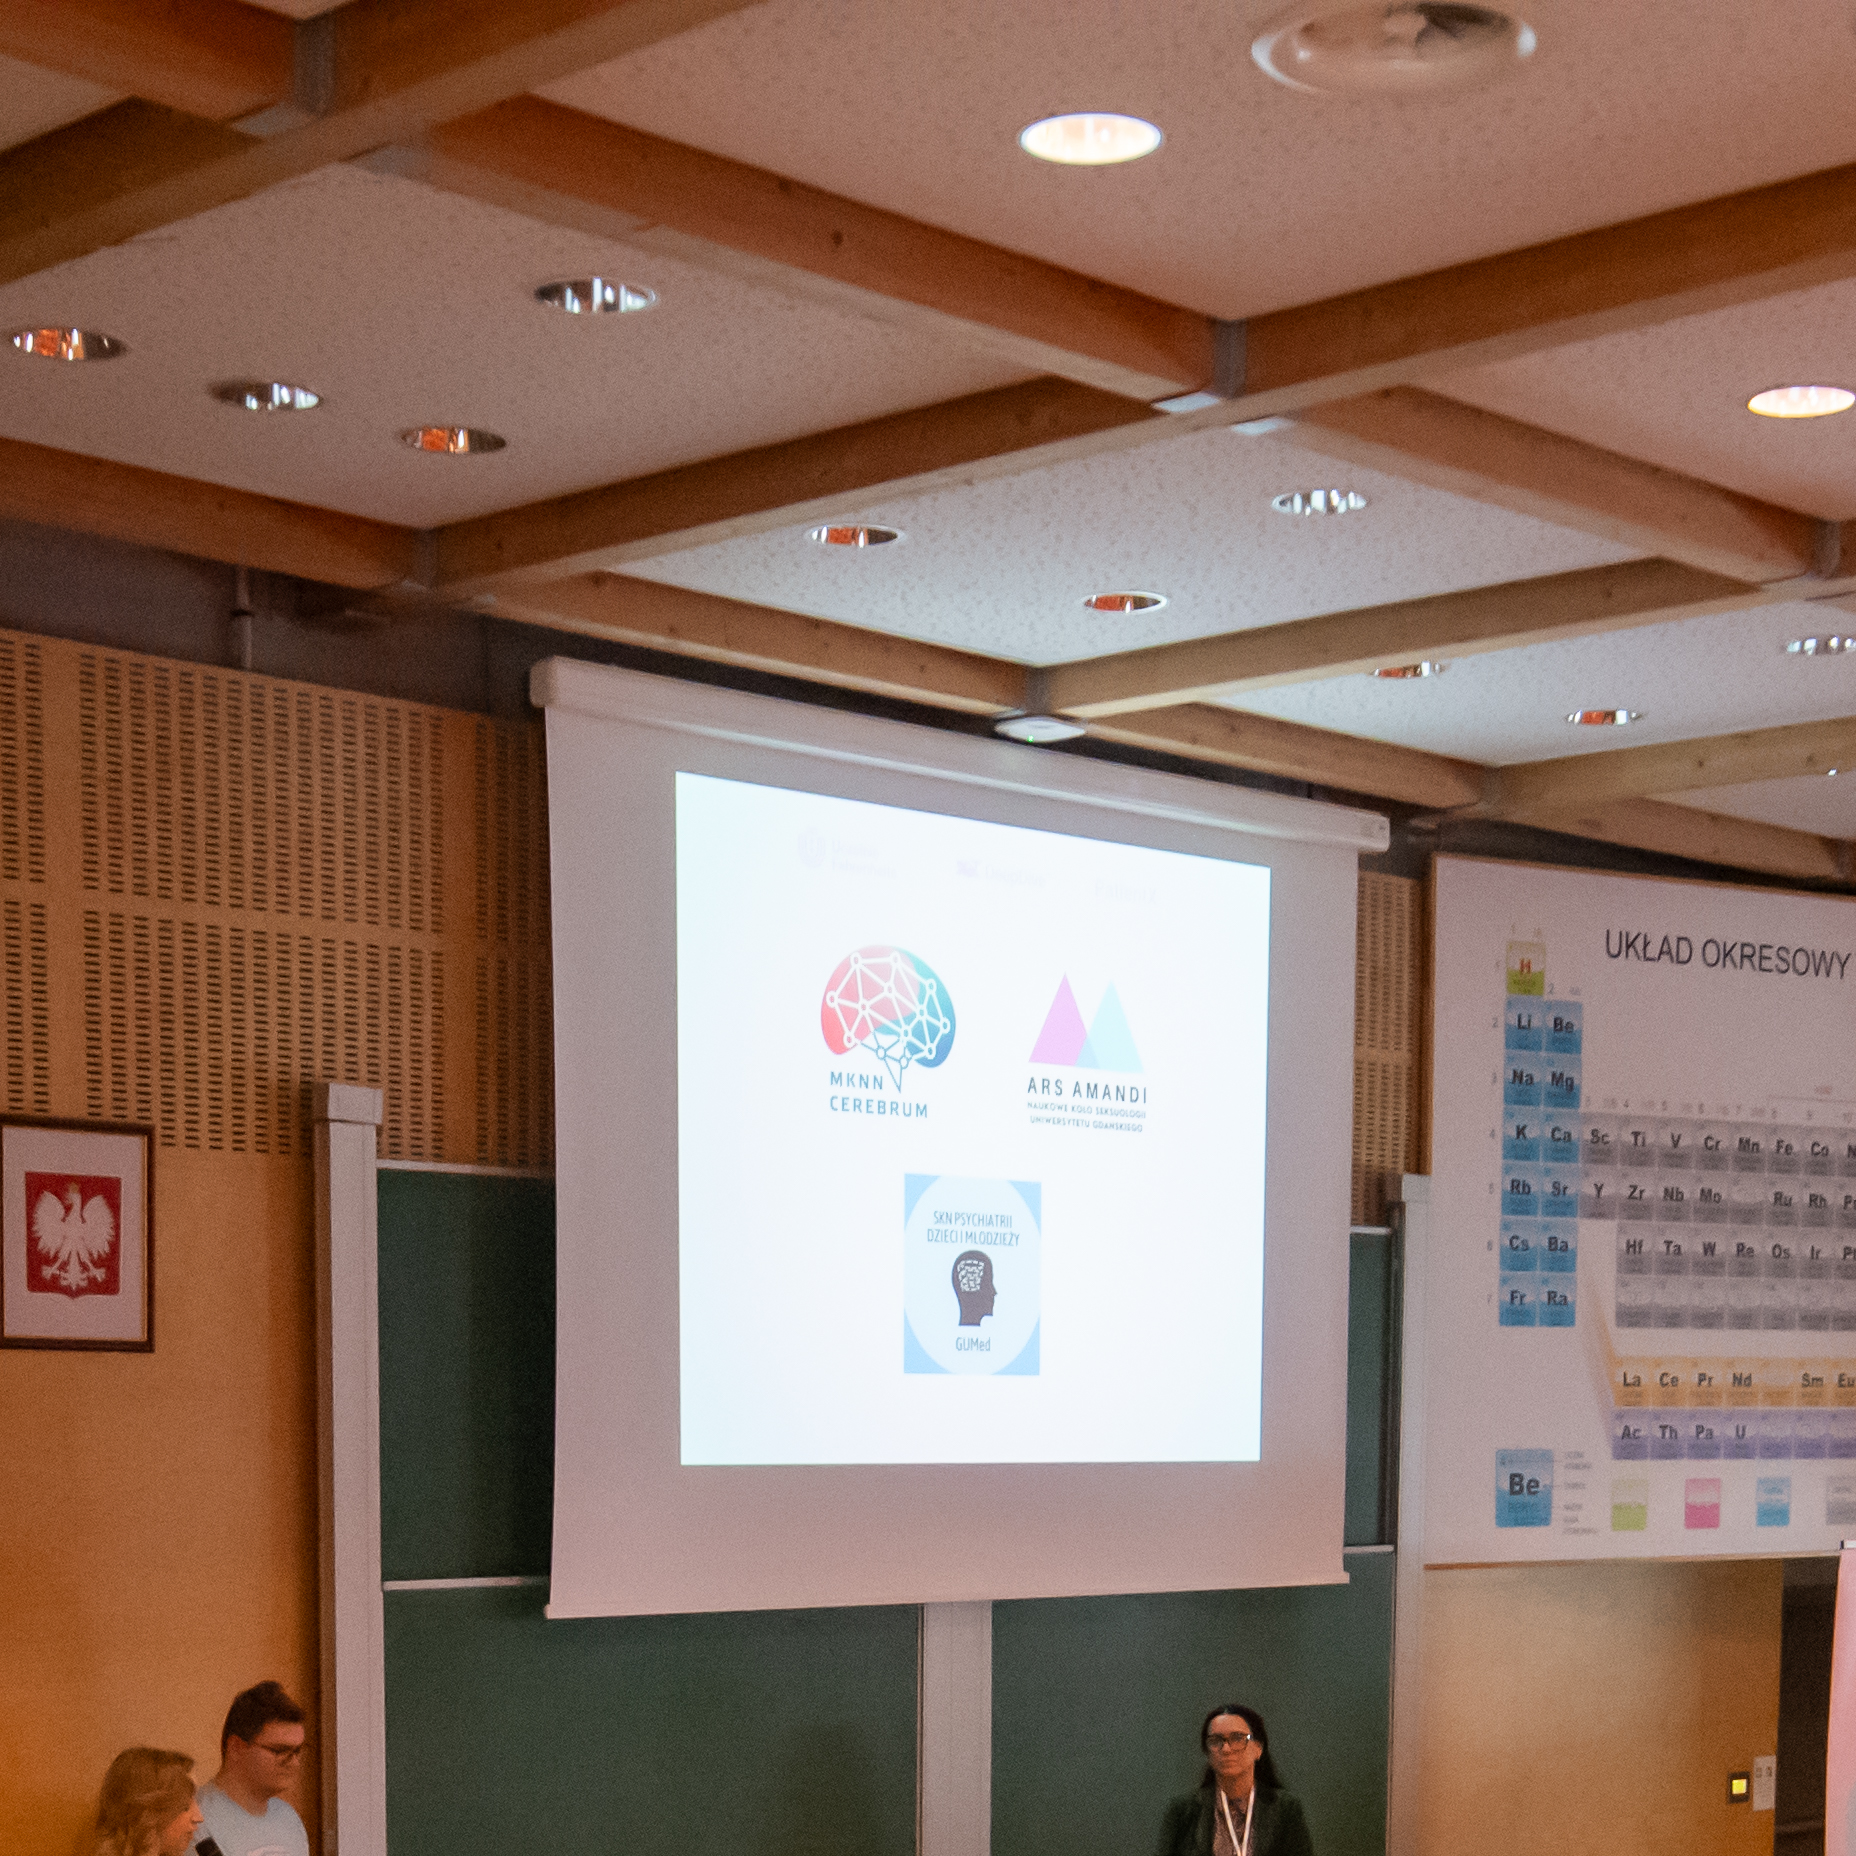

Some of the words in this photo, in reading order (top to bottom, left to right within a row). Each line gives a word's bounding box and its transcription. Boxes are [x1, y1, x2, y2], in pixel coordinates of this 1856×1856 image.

[1604, 929, 1693, 965] UKŁAD
[1701, 938, 1852, 980] OKRESOWY
[1517, 1013, 1532, 1030] Li
[1553, 1016, 1574, 1033] Be
[830, 1070, 883, 1091] MKNN
[1027, 1076, 1063, 1097] ARS
[1072, 1080, 1147, 1105] AMANDI
[1511, 1069, 1534, 1086] Na
[1551, 1071, 1574, 1092] Mg
[829, 1095, 928, 1119] CEREBRUM
[1027, 1101, 1068, 1113] NAUKOWE
[1515, 1125, 1527, 1140] K
[1550, 1127, 1572, 1143] Ca
[1590, 1129, 1610, 1146] Sc
[1631, 1130, 1646, 1147] Ti
[1670, 1133, 1681, 1149] V
[1704, 1135, 1721, 1151] Cr
[1738, 1137, 1760, 1153] Mn
[1776, 1139, 1793, 1156] Fe
[1510, 1179, 1531, 1196] Rb
[1551, 1181, 1568, 1198] Sr
[1594, 1182, 1604, 1199] Y
[1628, 1184, 1646, 1201] Zr
[1663, 1186, 1684, 1203] Nb
[1699, 1187, 1722, 1205] Mo
[1774, 1191, 1793, 1207] Ru
[1809, 1193, 1827, 1209] Rh
[933, 1210, 953, 1225] SKN
[954, 1212, 1013, 1229] PSYCHIATRII
[927, 1228, 958, 1244] DZIECI
[1508, 1235, 1530, 1253] Cs
[1548, 1236, 1569, 1253] Ba
[1625, 1238, 1644, 1255] Hf
[1663, 1239, 1682, 1256] Ta
[1702, 1241, 1717, 1257] W
[1772, 1243, 1791, 1260] Os
[1510, 1289, 1527, 1306] Fr
[1547, 1290, 1568, 1307] Ra
[955, 1336, 991, 1352] GUMed
[1622, 1371, 1641, 1388] La
[1659, 1372, 1679, 1388] Ce
[1697, 1372, 1714, 1388] Pr
[1732, 1372, 1752, 1388] Nd
[1801, 1372, 1824, 1388] Sm
[1837, 1372, 1856, 1388] Eu
[1621, 1424, 1641, 1440] Ac
[1658, 1424, 1678, 1440] Th
[1695, 1424, 1714, 1440] Pa
[1735, 1424, 1746, 1440] U
[1509, 1472, 1540, 1496] Be
